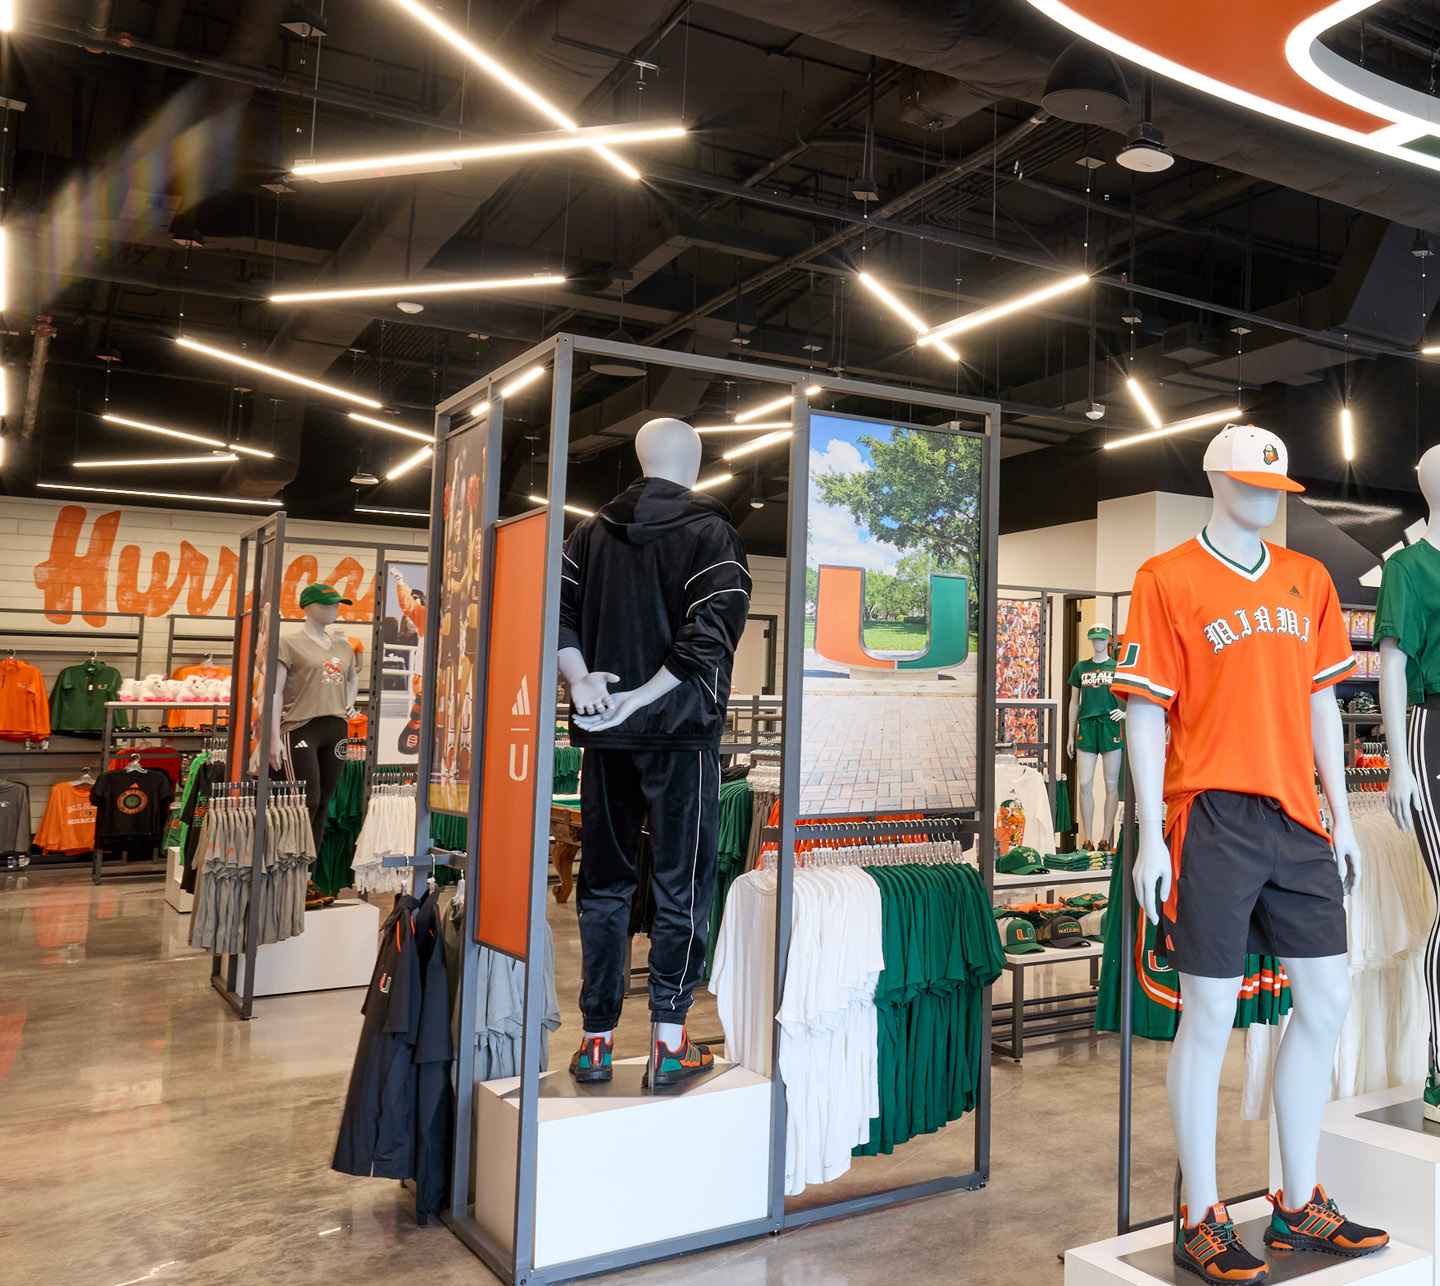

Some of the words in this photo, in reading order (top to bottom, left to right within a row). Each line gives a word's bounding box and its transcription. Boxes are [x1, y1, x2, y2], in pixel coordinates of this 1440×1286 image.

[814, 564, 969, 669] U
[1203, 605, 1311, 655] MIAMI
[509, 743, 529, 781] U
